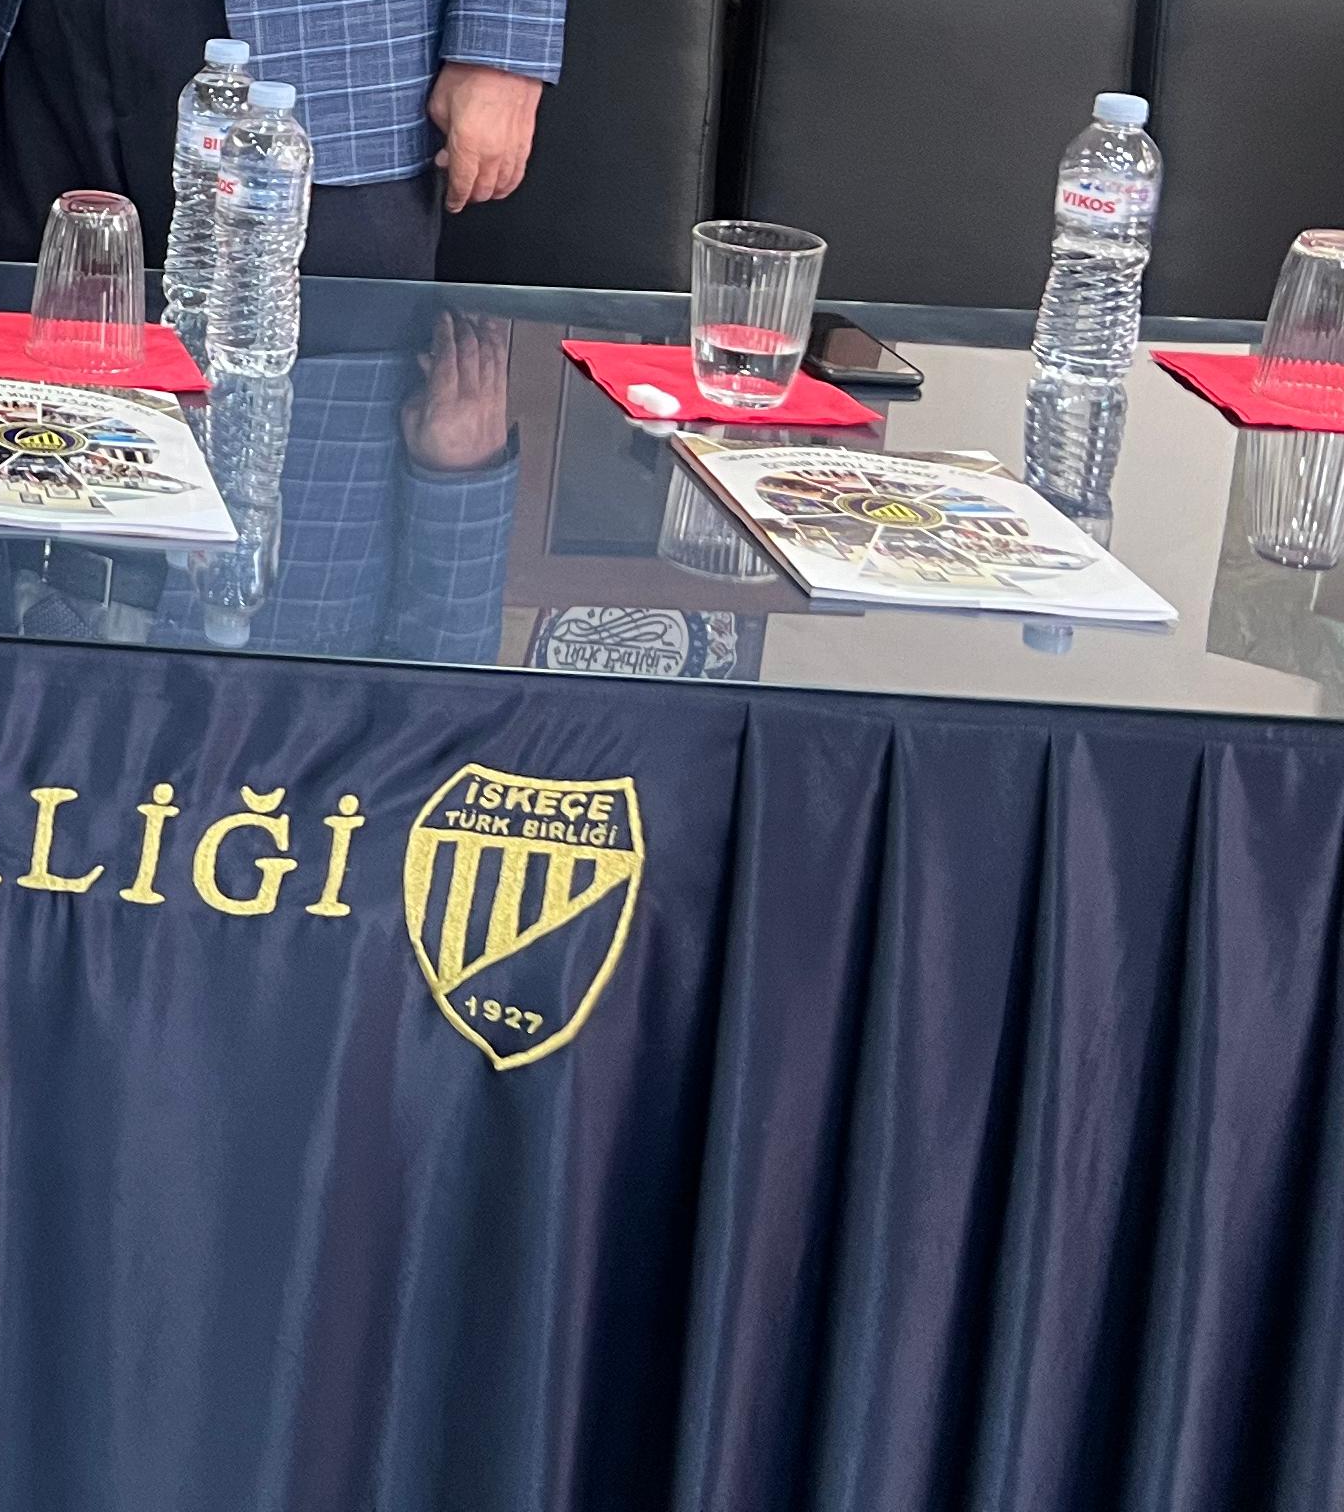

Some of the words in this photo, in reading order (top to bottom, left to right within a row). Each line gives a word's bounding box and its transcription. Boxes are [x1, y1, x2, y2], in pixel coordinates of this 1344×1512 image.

[1062, 189, 1116, 214] VIKOS
[465, 776, 615, 821] İSKEÇE
[445, 808, 511, 836] TÜRK
[522, 818, 619, 846] BİRLİĞİ
[464, 995, 544, 1035] 1927
